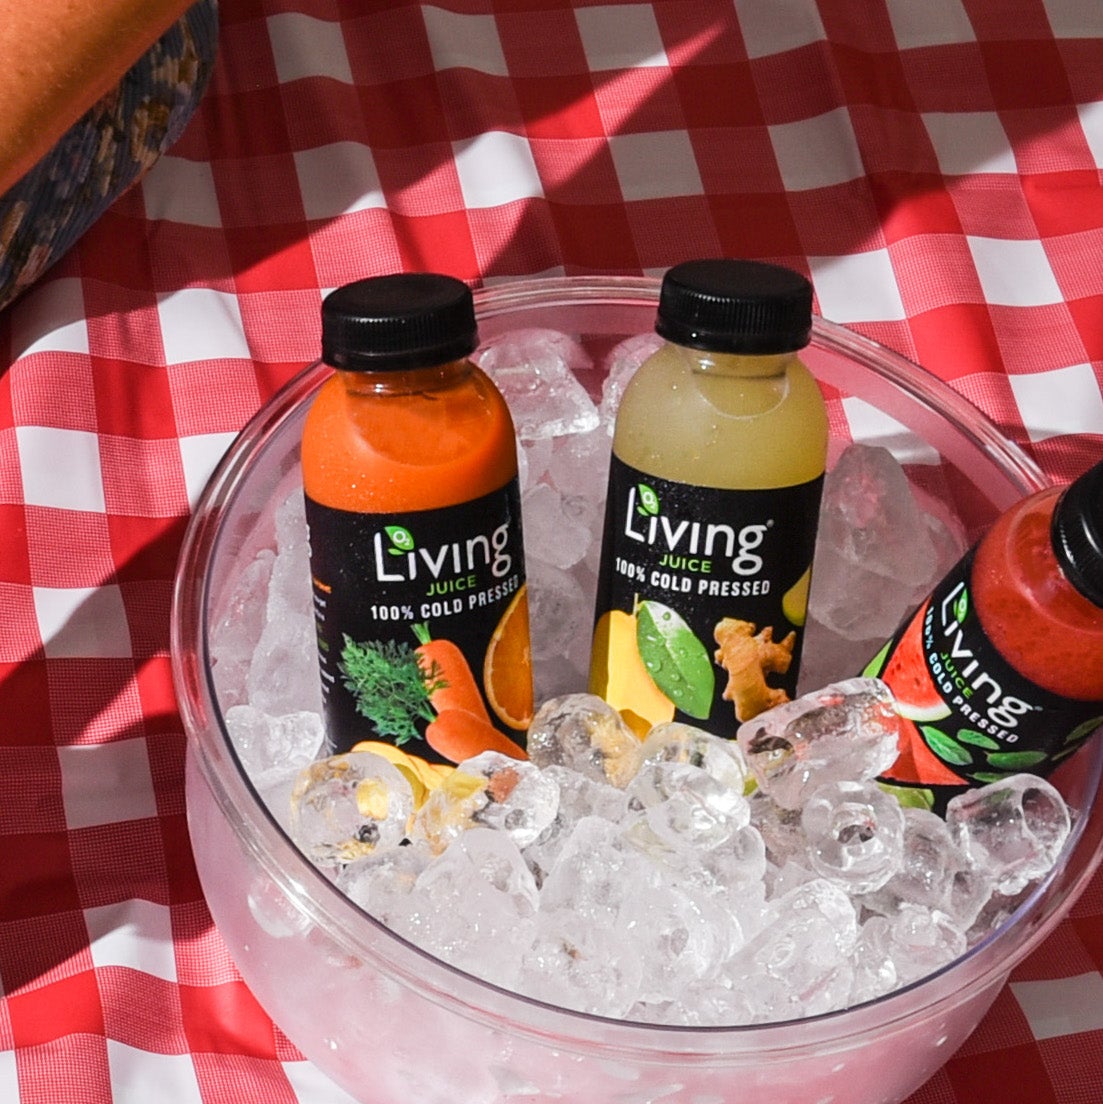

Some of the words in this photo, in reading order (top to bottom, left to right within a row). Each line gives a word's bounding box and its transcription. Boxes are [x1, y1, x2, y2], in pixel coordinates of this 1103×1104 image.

[374, 523, 512, 582] Living
[624, 486, 768, 576] Living
[426, 574, 477, 596] JUICE
[615, 557, 646, 582] 100%
[650, 571, 692, 593] COLD
[697, 579, 770, 596] PRESSED
[659, 554, 712, 573] JUICE
[370, 604, 414, 620] 100%
[420, 599, 463, 618] COLD
[468, 574, 519, 610] PRESSED
[924, 606, 935, 650] 100%
[928, 652, 953, 694] COLD
[940, 652, 974, 699] JUICE
[941, 581, 1033, 728] Living
[952, 695, 1019, 744] PRESSED
